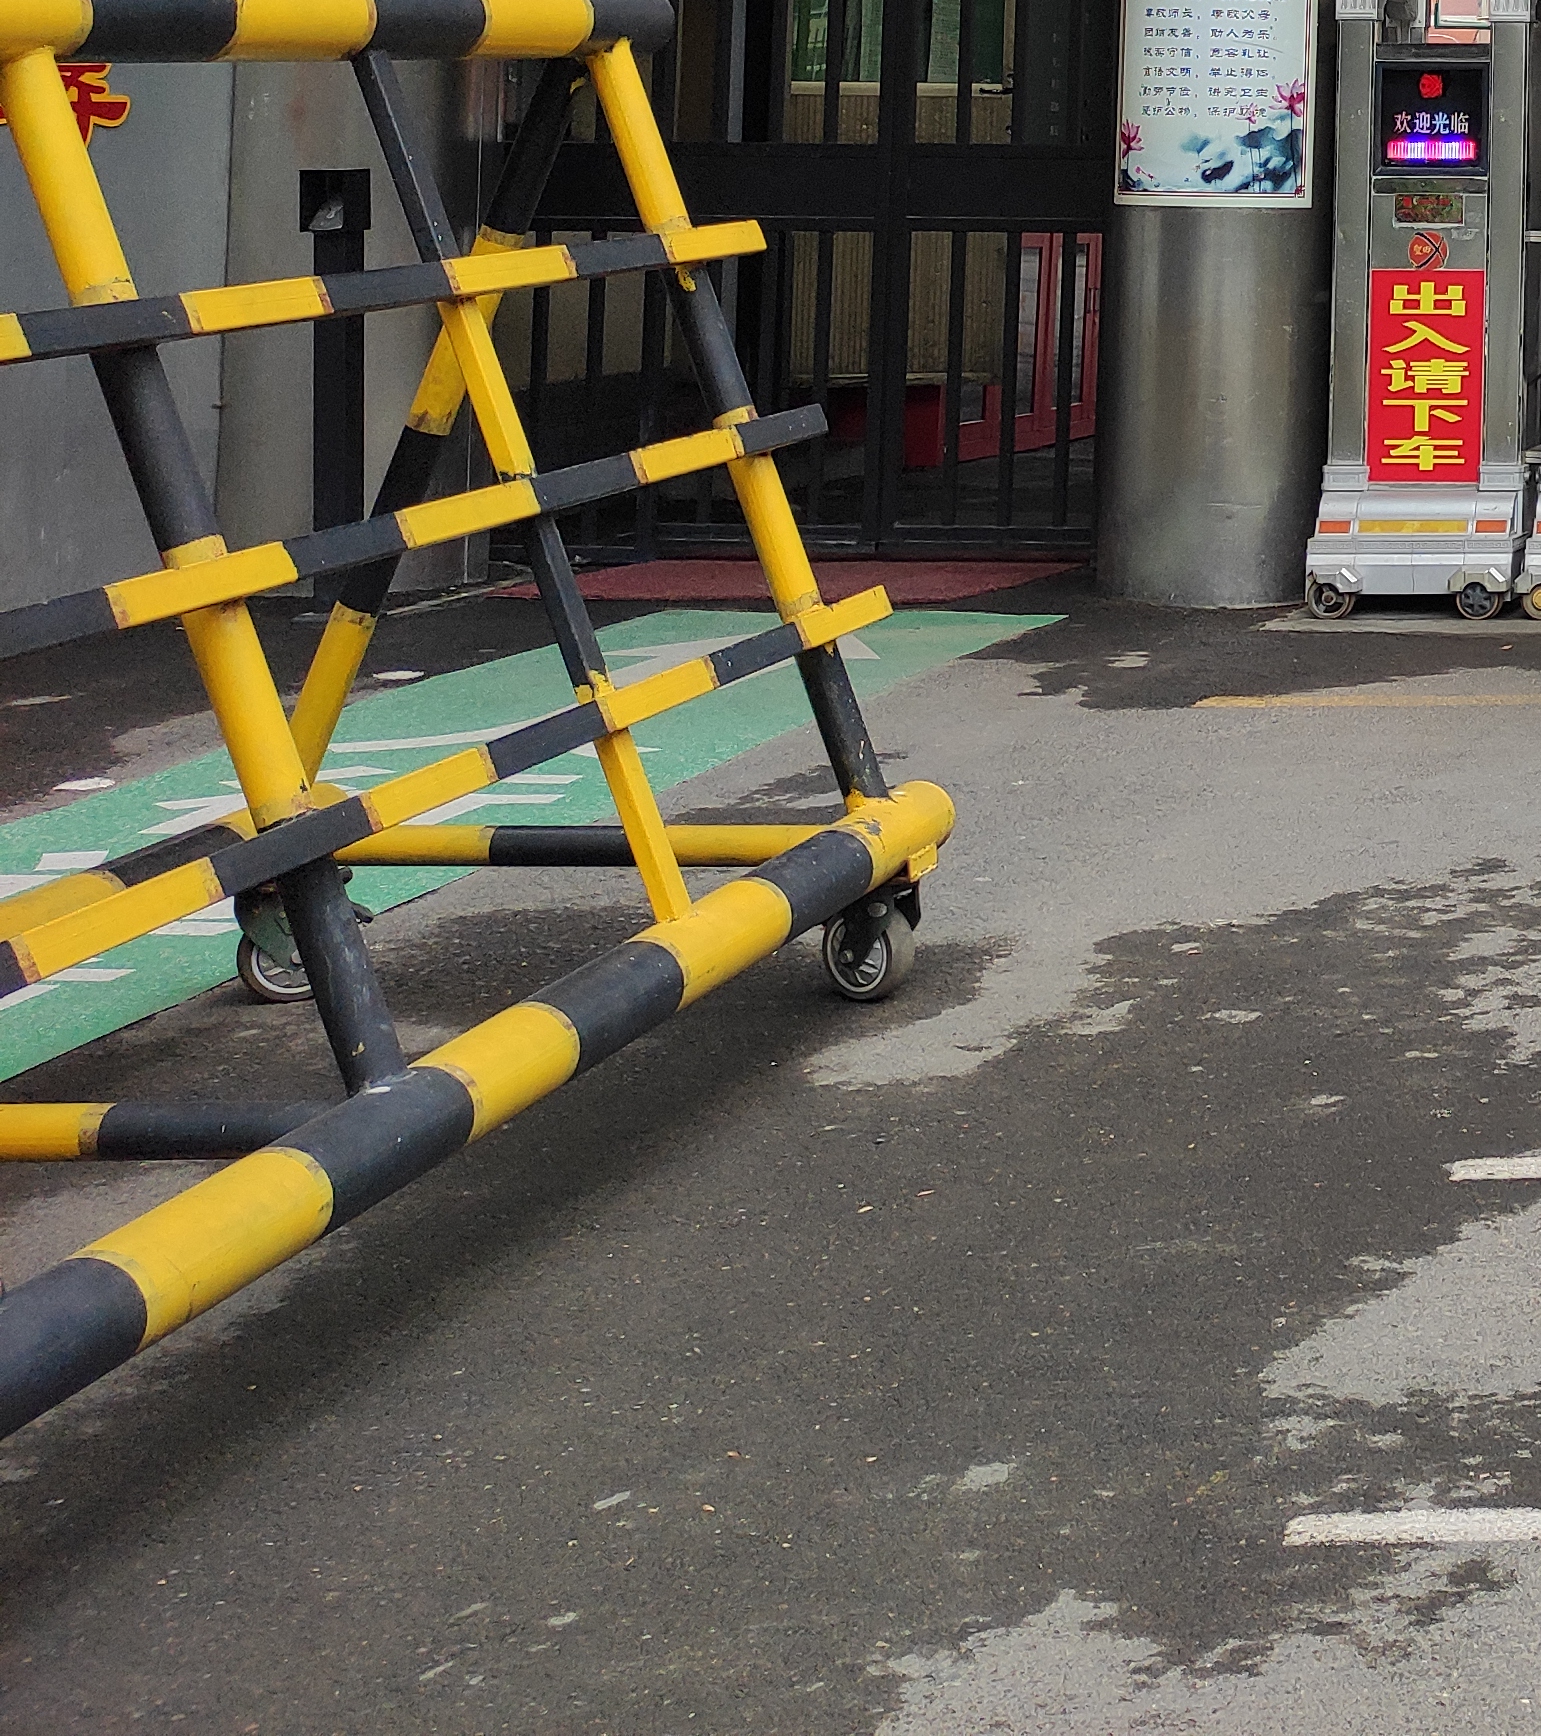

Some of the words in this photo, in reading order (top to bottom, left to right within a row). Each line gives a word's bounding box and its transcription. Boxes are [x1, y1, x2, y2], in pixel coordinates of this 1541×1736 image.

[1394, 112, 1469, 135] 欢迎光临
[1380, 281, 1470, 471] 出入请下车
